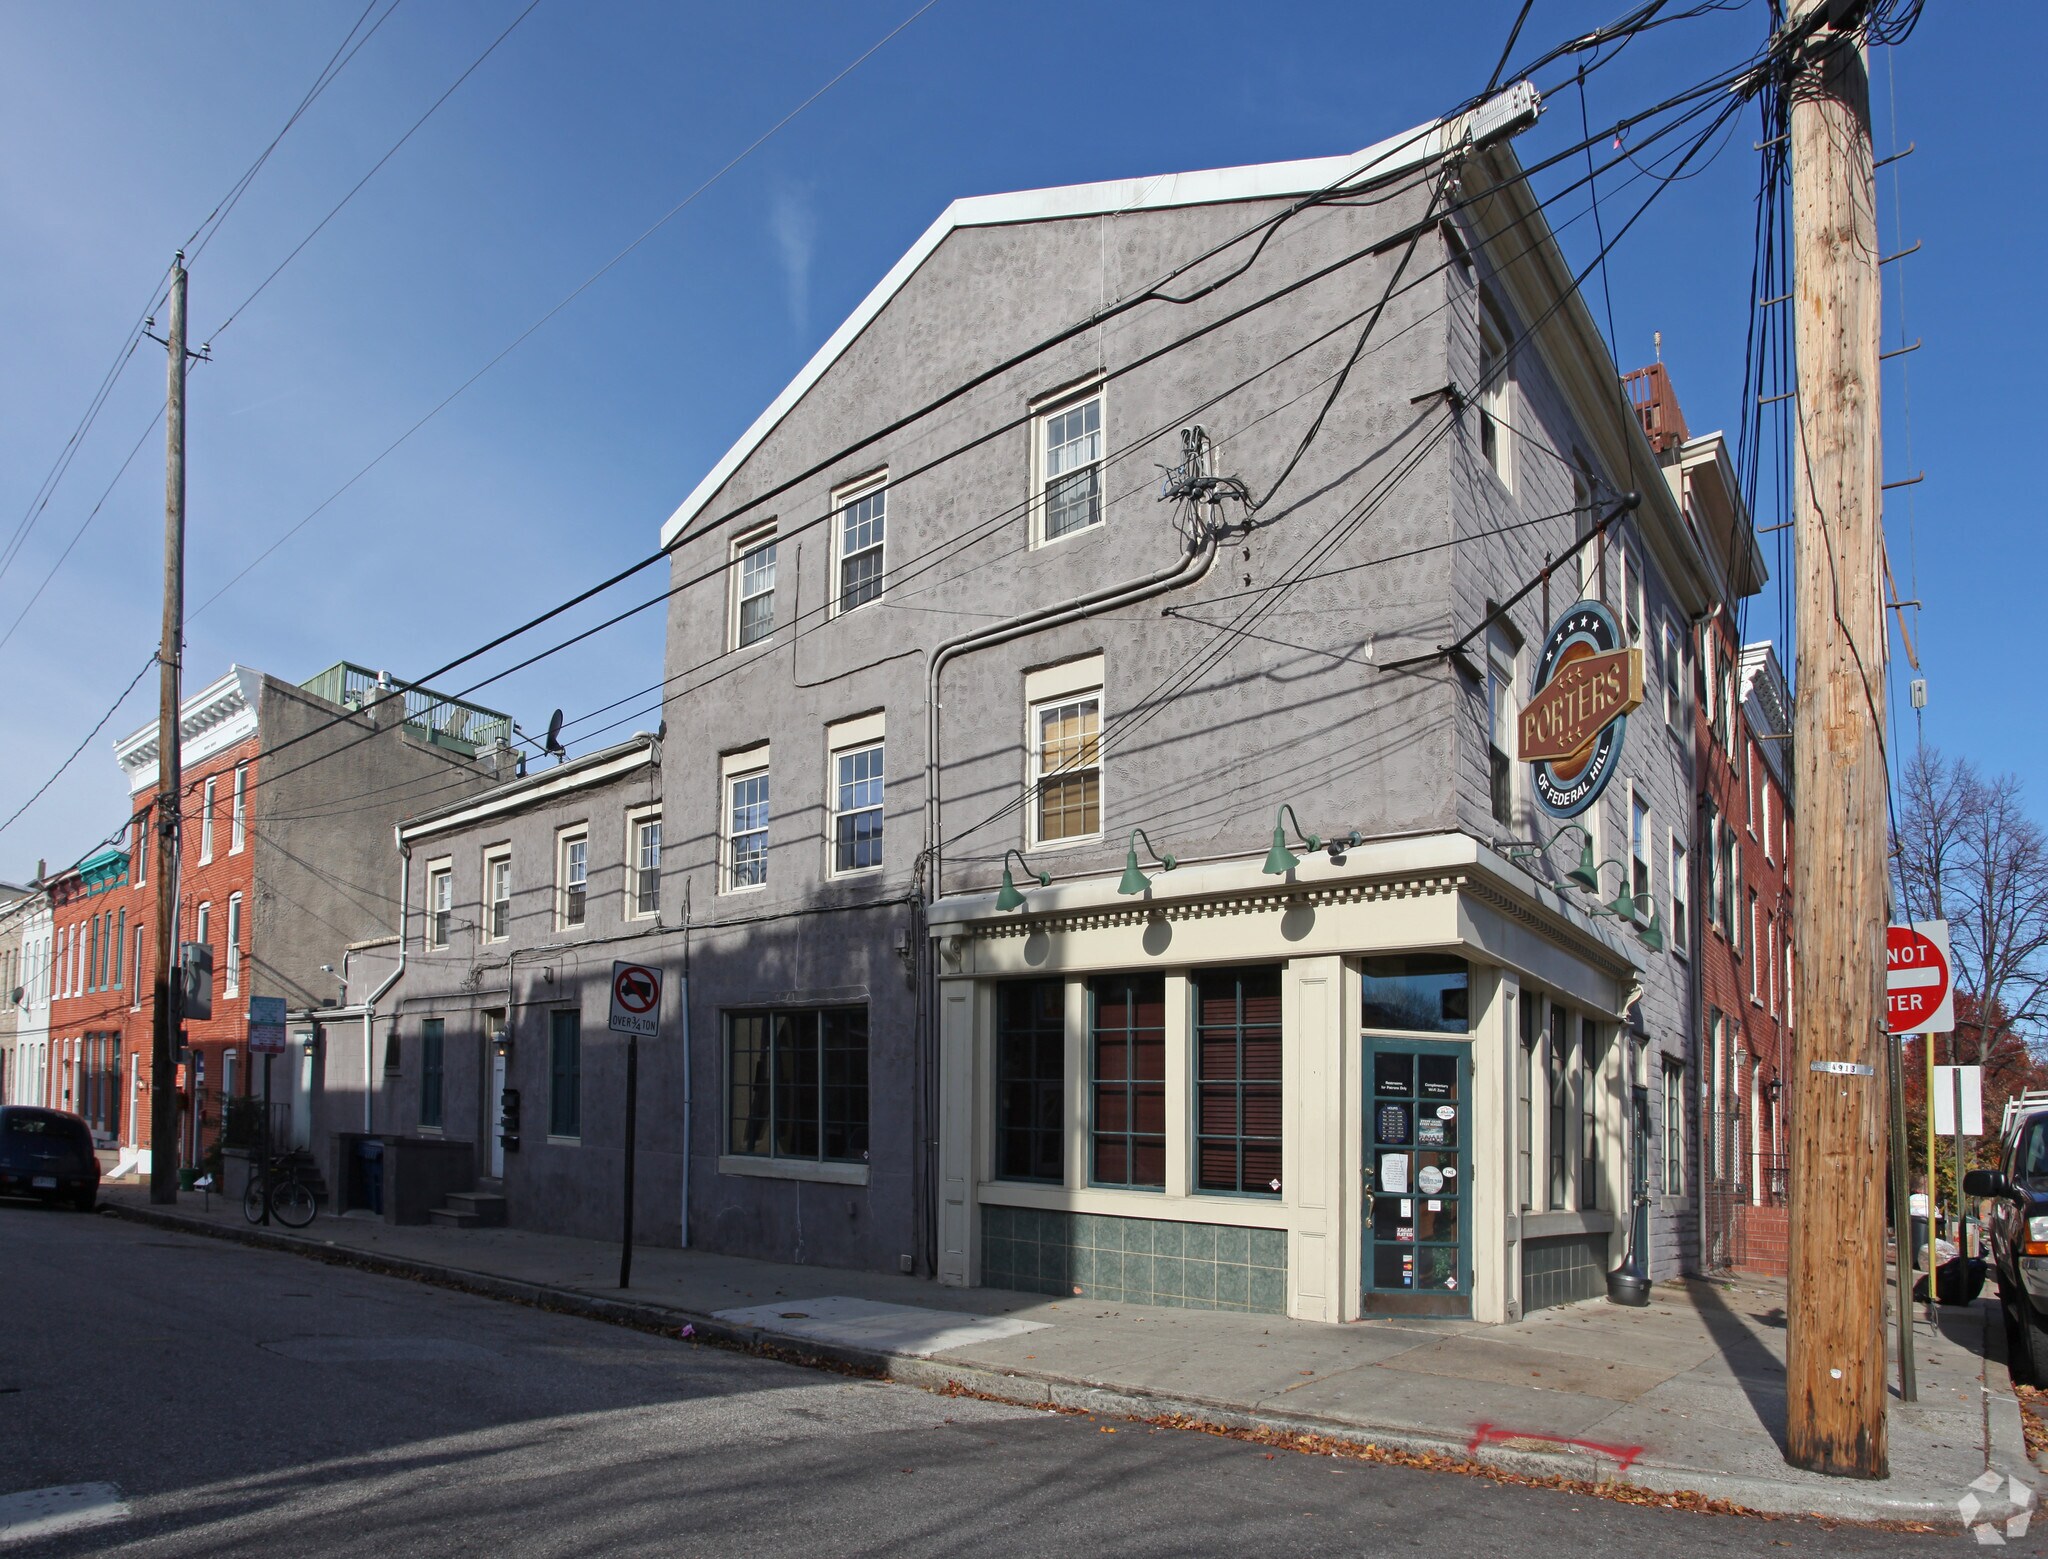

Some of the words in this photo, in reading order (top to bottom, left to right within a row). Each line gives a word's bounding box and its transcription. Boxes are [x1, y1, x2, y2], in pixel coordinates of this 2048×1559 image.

[1524, 662, 1619, 750] PORTERS
[1537, 772, 1549, 791] OF
[1546, 783, 1590, 806] FEDERAL
[1589, 743, 1609, 780] HILL
[1887, 945, 1928, 965] NOT
[1887, 994, 1923, 1012] TER
[612, 1015, 631, 1028] OVER
[642, 1019, 656, 1031] TON
[1832, 1064, 1856, 1073] 4913
